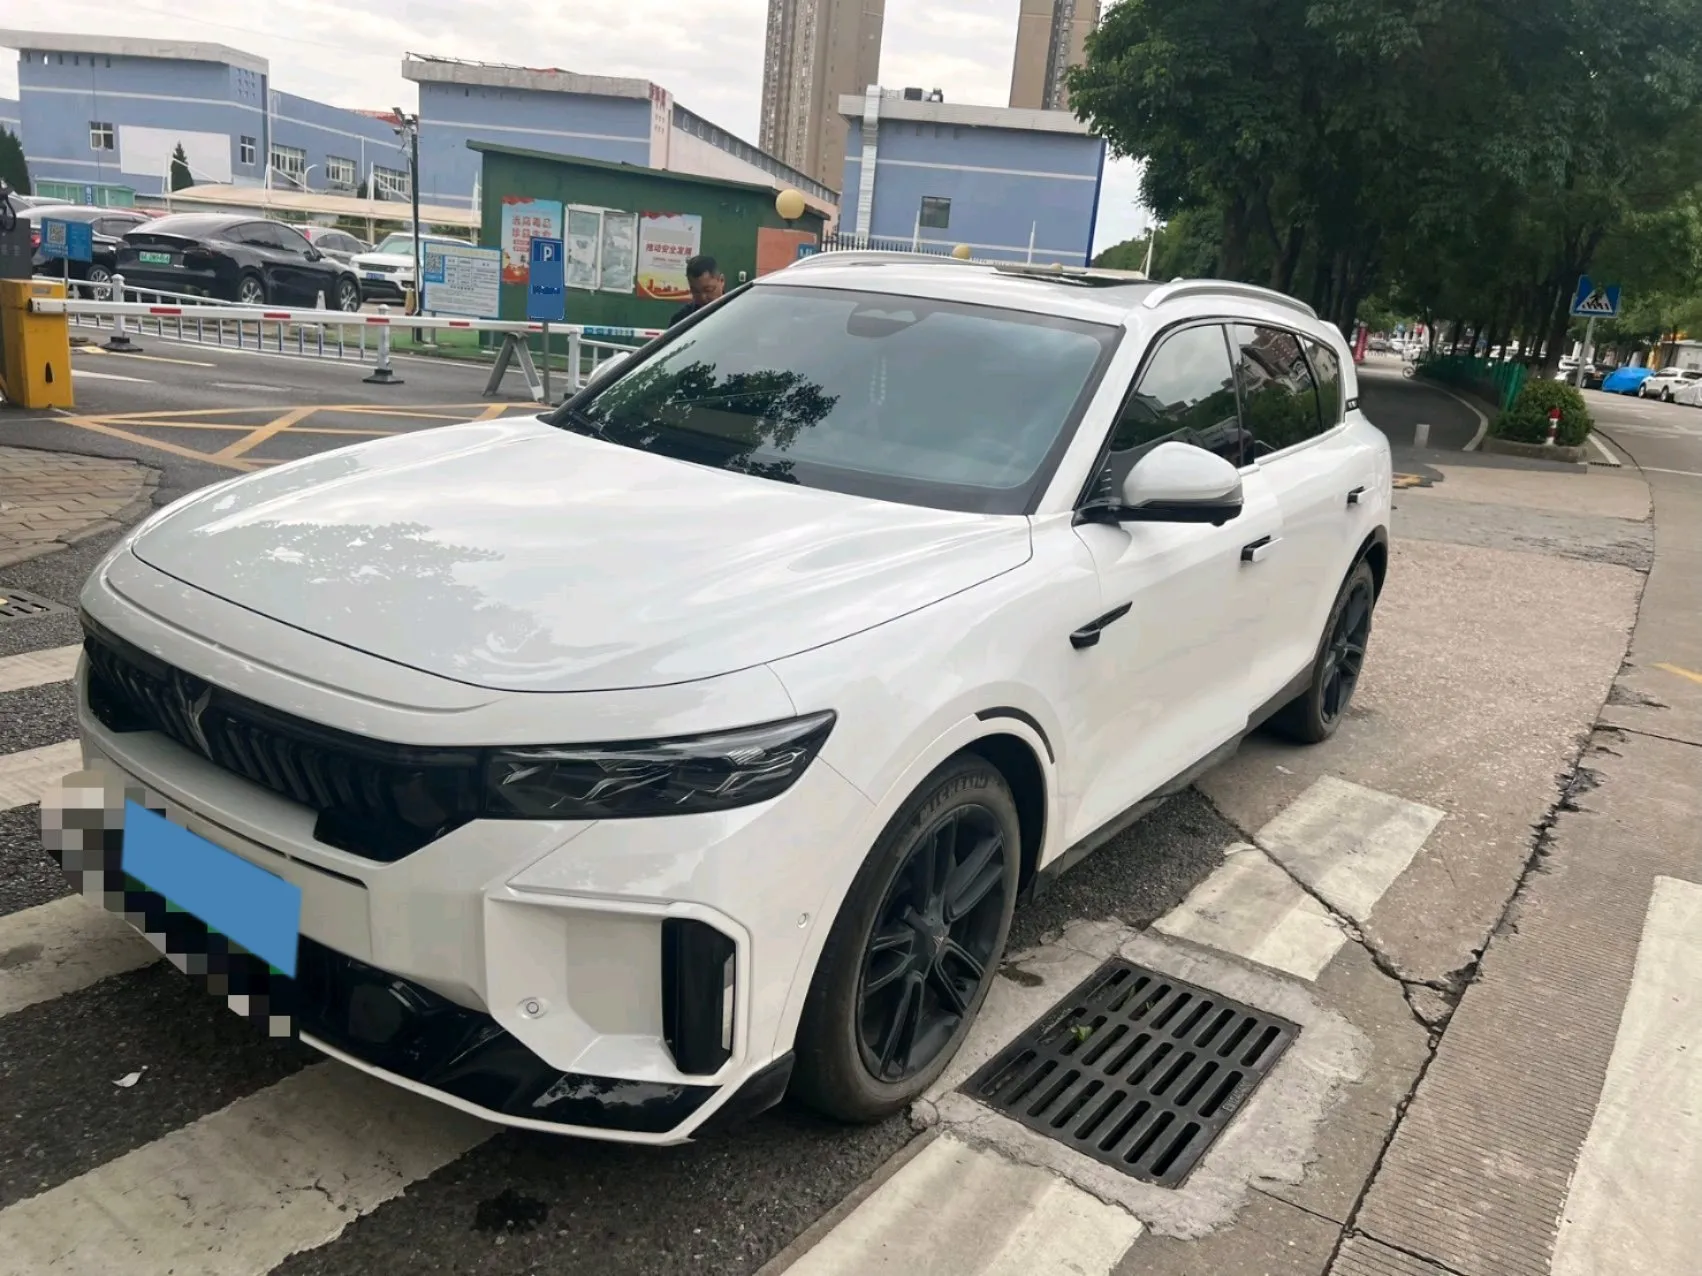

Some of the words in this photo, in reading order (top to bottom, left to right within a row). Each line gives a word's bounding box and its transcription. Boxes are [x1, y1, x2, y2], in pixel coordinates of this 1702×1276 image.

[543, 246, 553, 261] P
[646, 243, 692, 256] 推动安全发展
